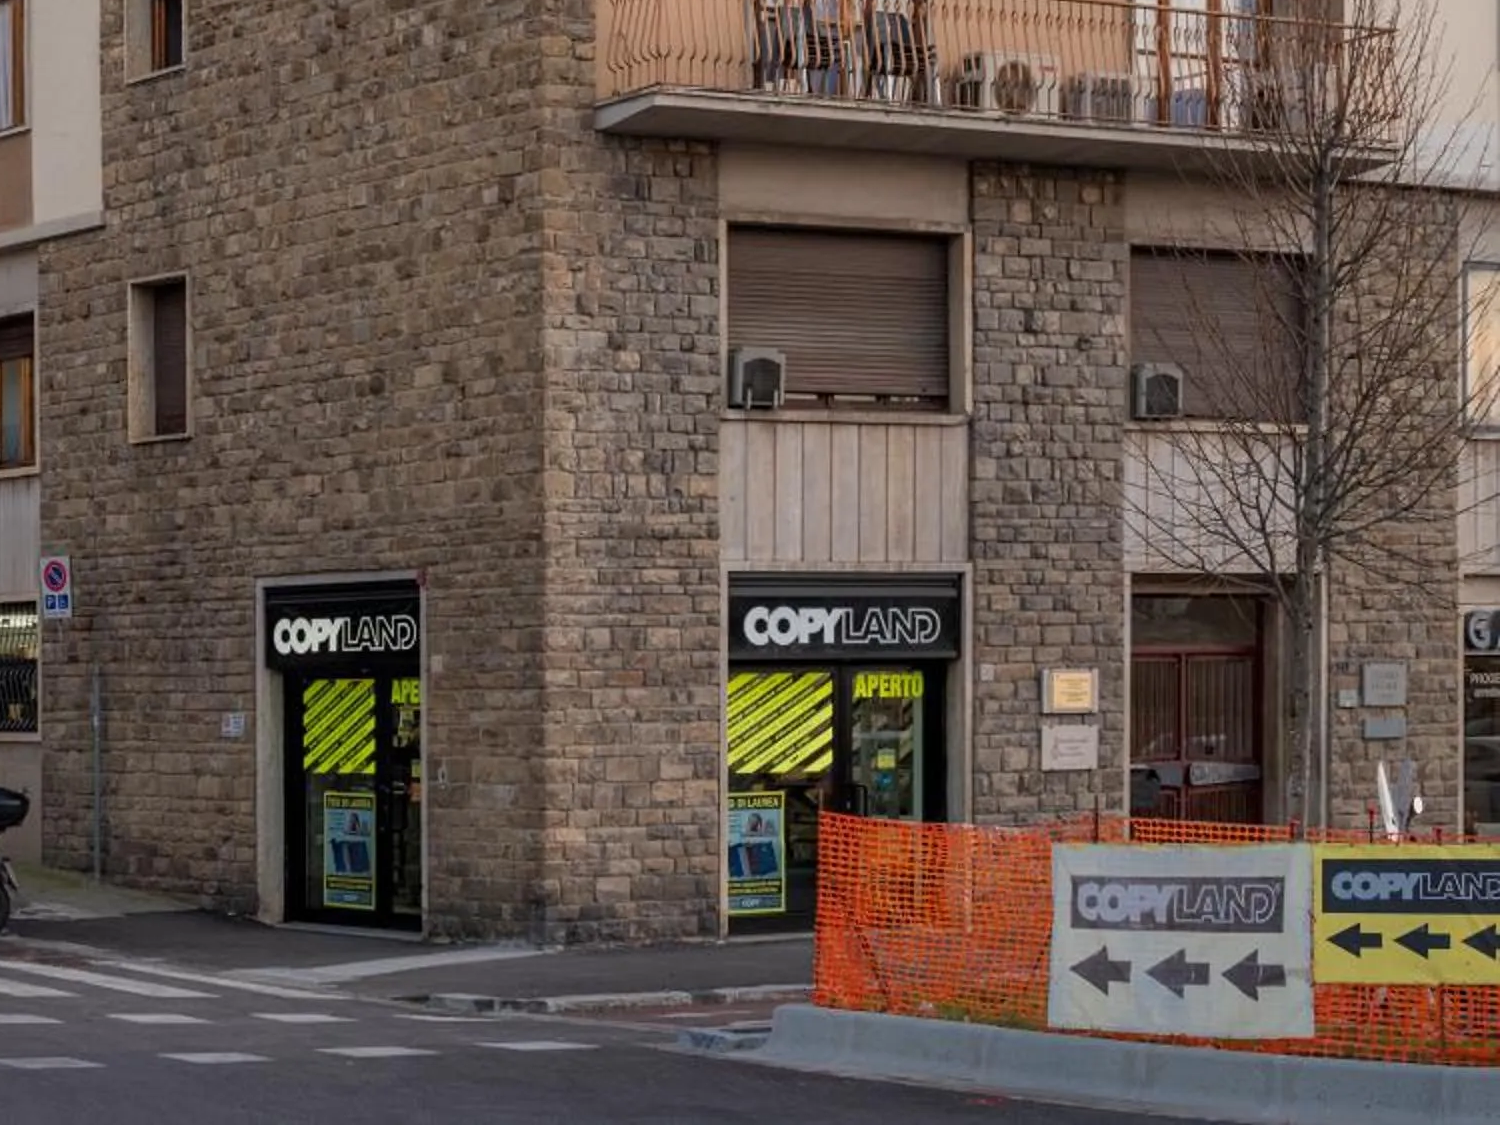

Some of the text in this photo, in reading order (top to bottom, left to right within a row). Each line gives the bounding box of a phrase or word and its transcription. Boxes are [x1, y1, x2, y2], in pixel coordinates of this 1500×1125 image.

[273, 614, 417, 655] COPYLAND
[743, 606, 941, 646] COPYLAND
[391, 679, 421, 704] APE
[855, 672, 924, 698] APERTO
[1077, 882, 1276, 924] COPYLAND
